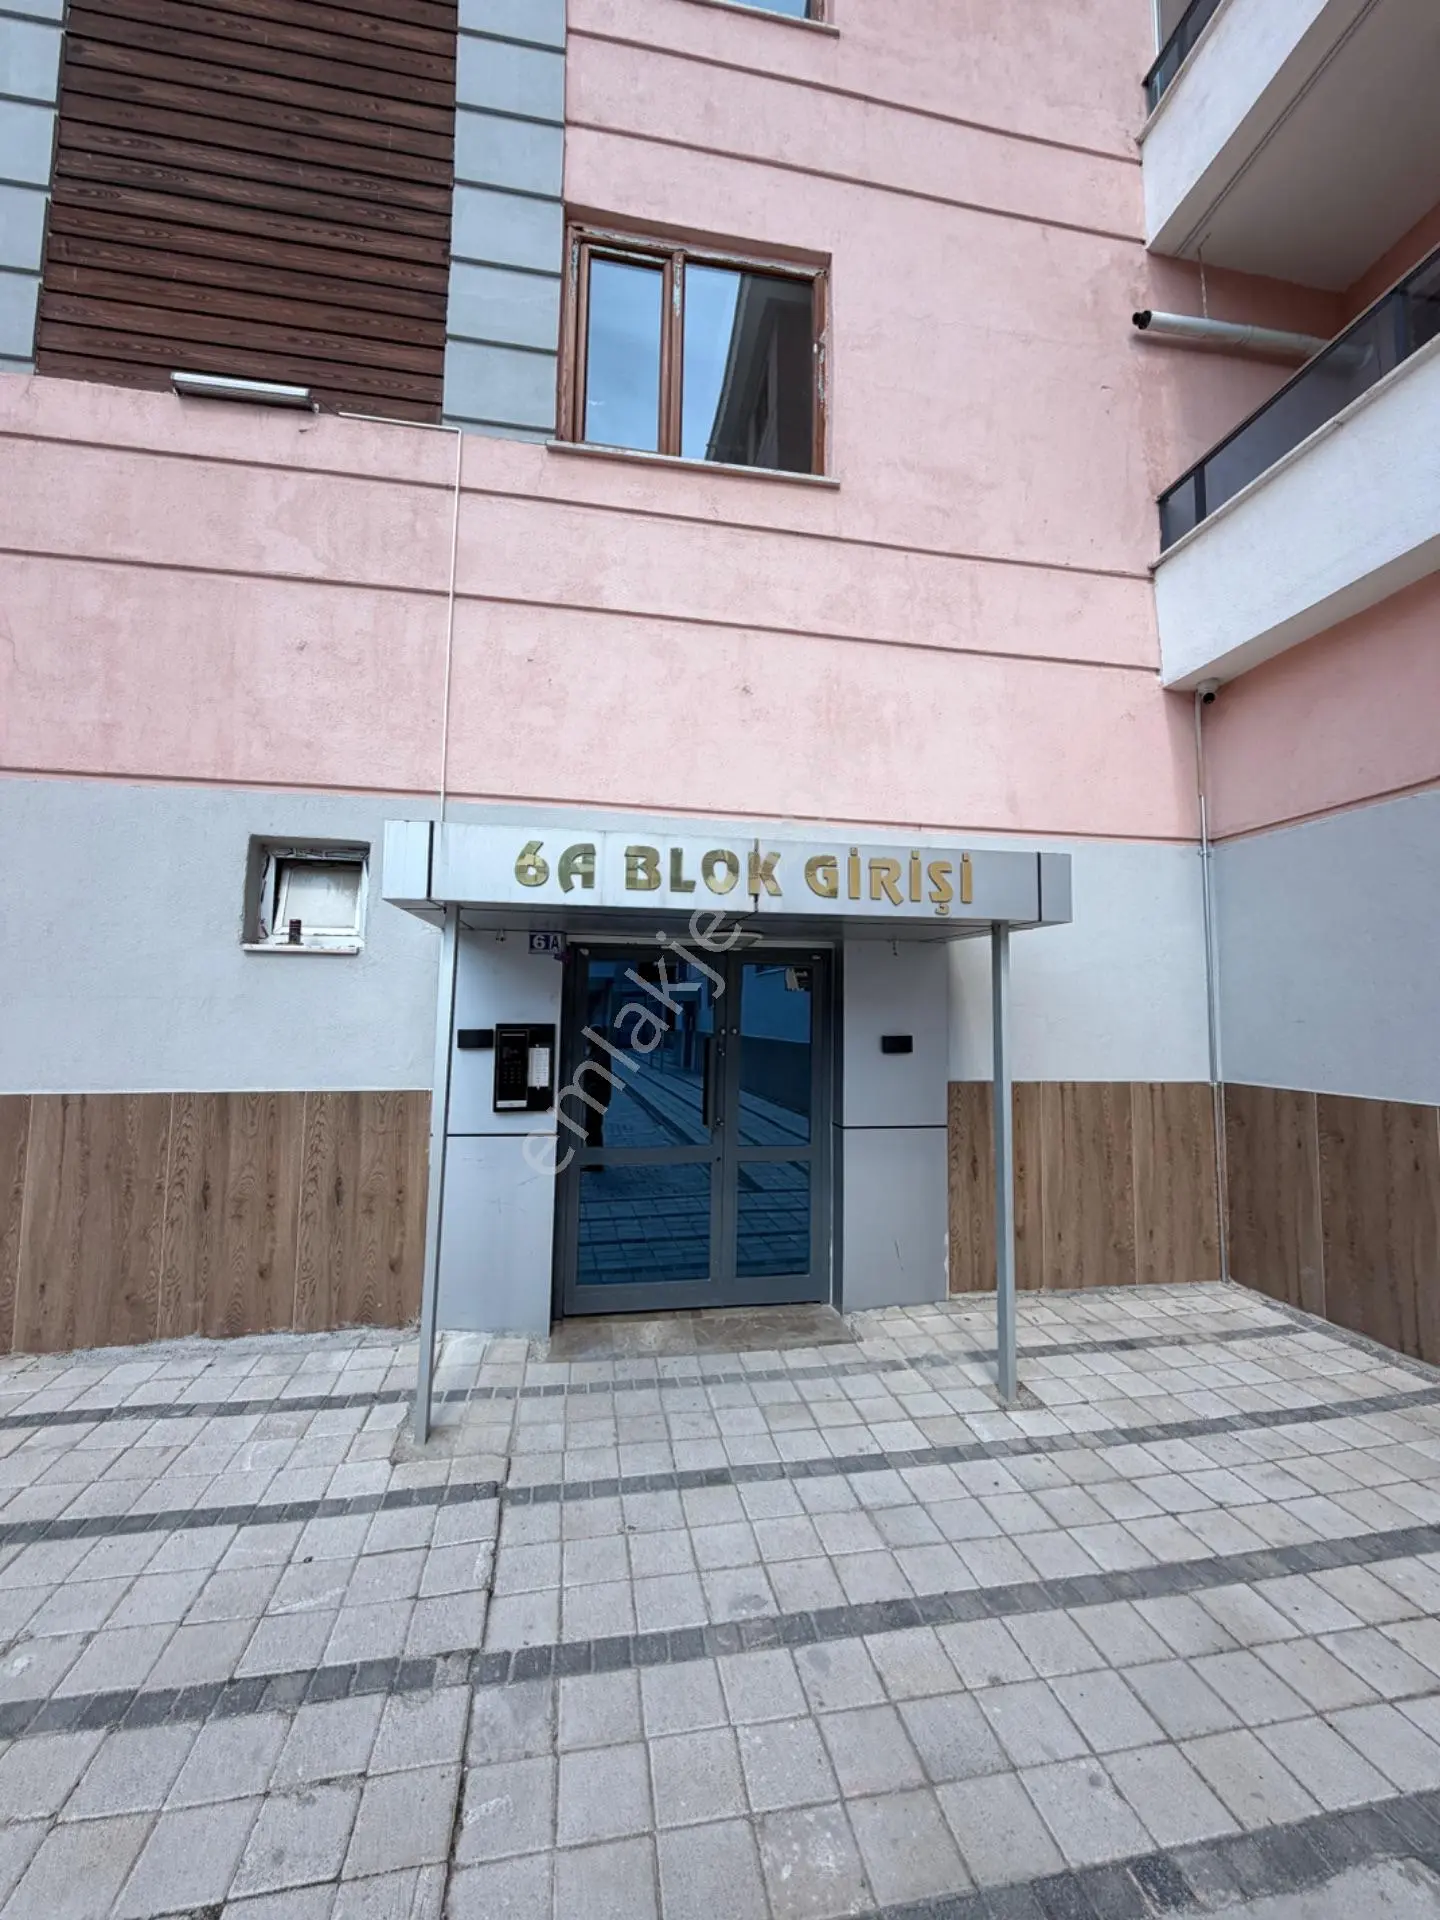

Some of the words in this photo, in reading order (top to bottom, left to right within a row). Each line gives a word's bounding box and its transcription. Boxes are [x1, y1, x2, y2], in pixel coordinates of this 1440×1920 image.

[514, 840, 597, 894] 6A
[624, 845, 783, 896] BLOK
[804, 847, 973, 915] GİRİŞİ
